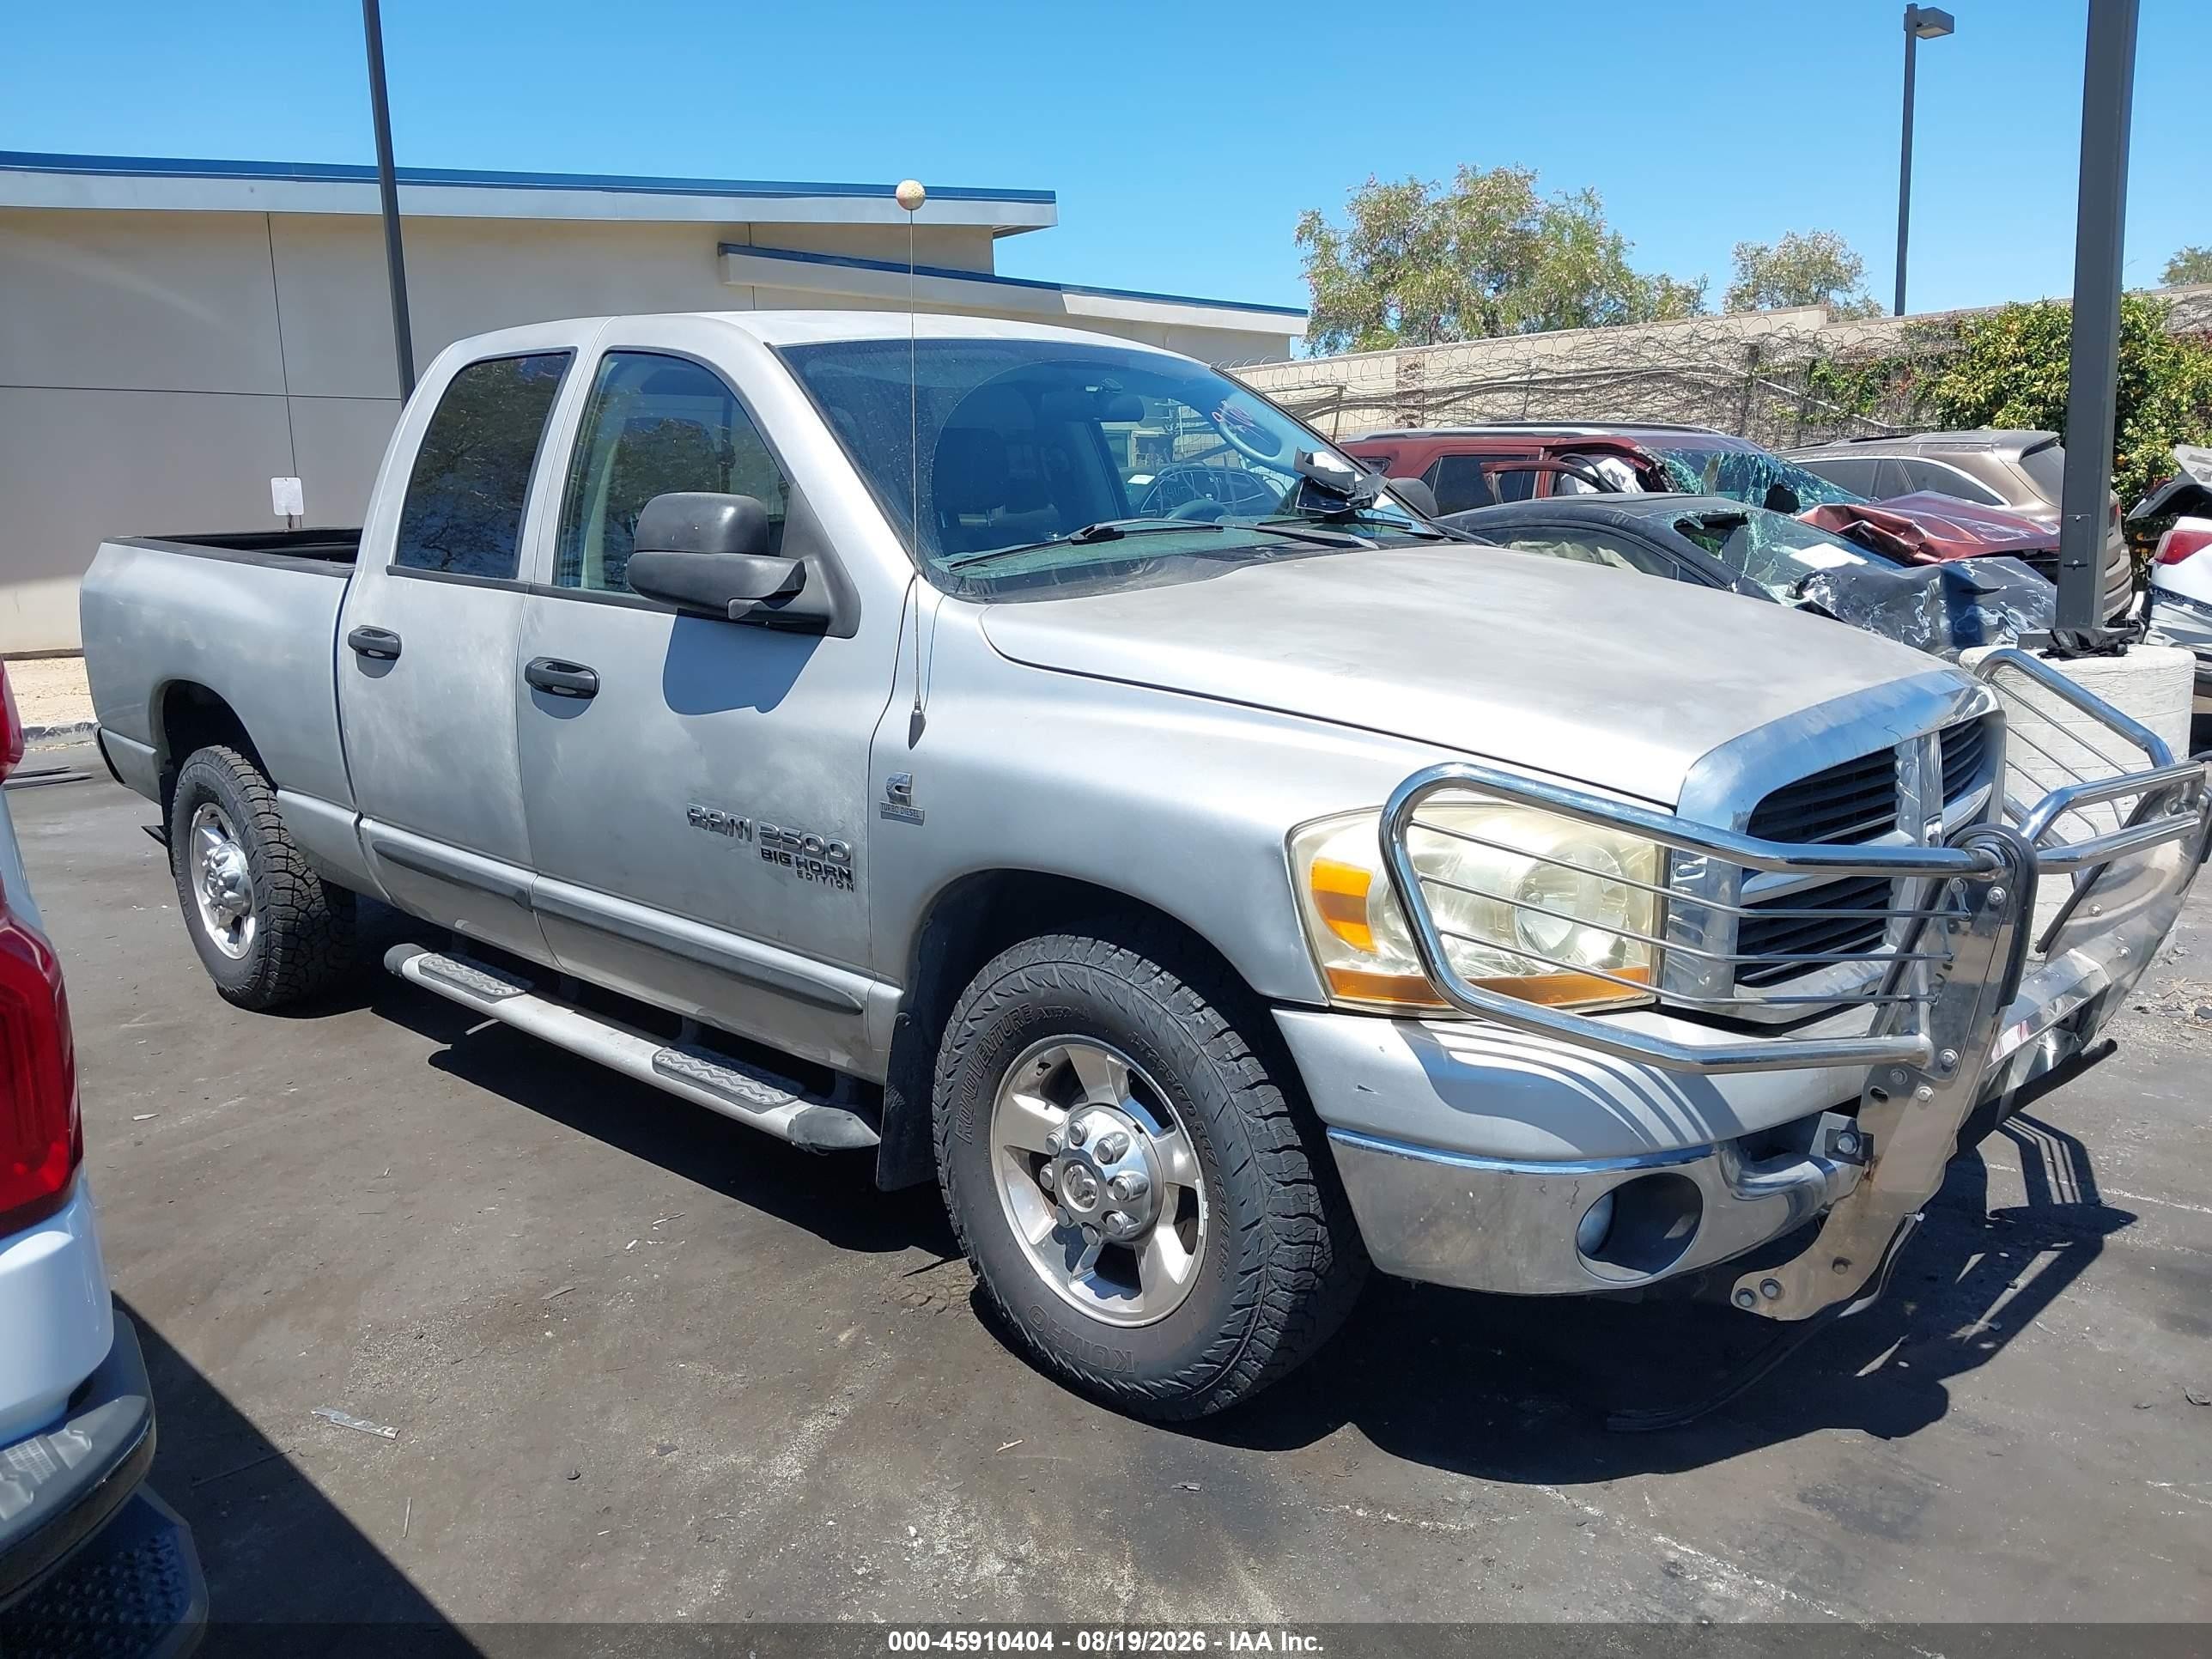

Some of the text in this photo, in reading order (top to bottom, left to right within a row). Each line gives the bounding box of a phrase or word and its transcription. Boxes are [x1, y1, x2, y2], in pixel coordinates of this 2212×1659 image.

[880, 802, 921, 818] TURBO DIESEL
[686, 802, 852, 867] RAM 2500
[761, 848, 853, 882] BIG HORN
[796, 870, 854, 893] EDITION
